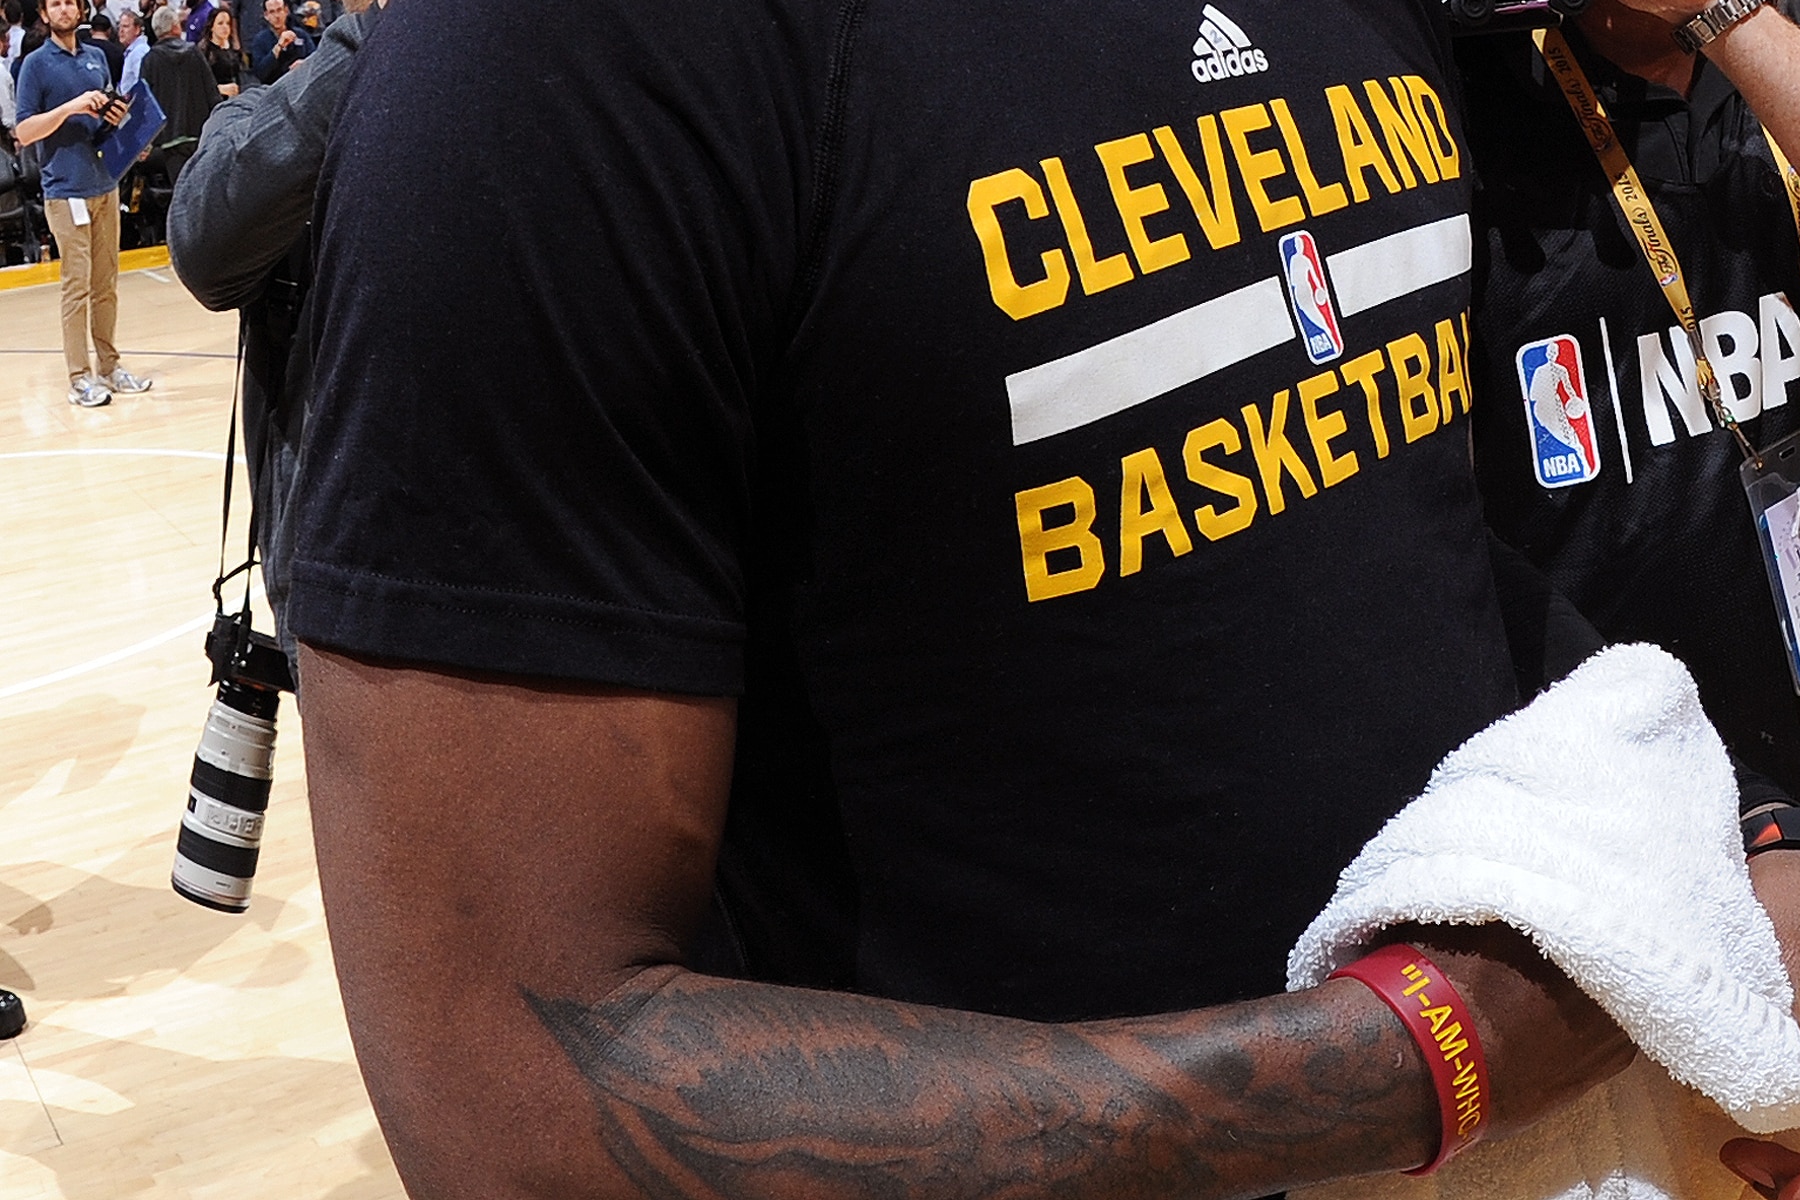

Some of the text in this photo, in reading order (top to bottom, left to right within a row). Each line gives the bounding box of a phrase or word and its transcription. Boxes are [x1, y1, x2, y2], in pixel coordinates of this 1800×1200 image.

[1209, 29, 1223, 44] 2
[1191, 48, 1269, 83] adidas
[967, 75, 1460, 320] CLEVELAND
[1615, 172, 1638, 202] 2015
[1680, 305, 1695, 331] 015
[1310, 332, 1334, 354] NBA
[1015, 306, 1473, 602] BASKETBA
[1544, 454, 1581, 479] NBA
